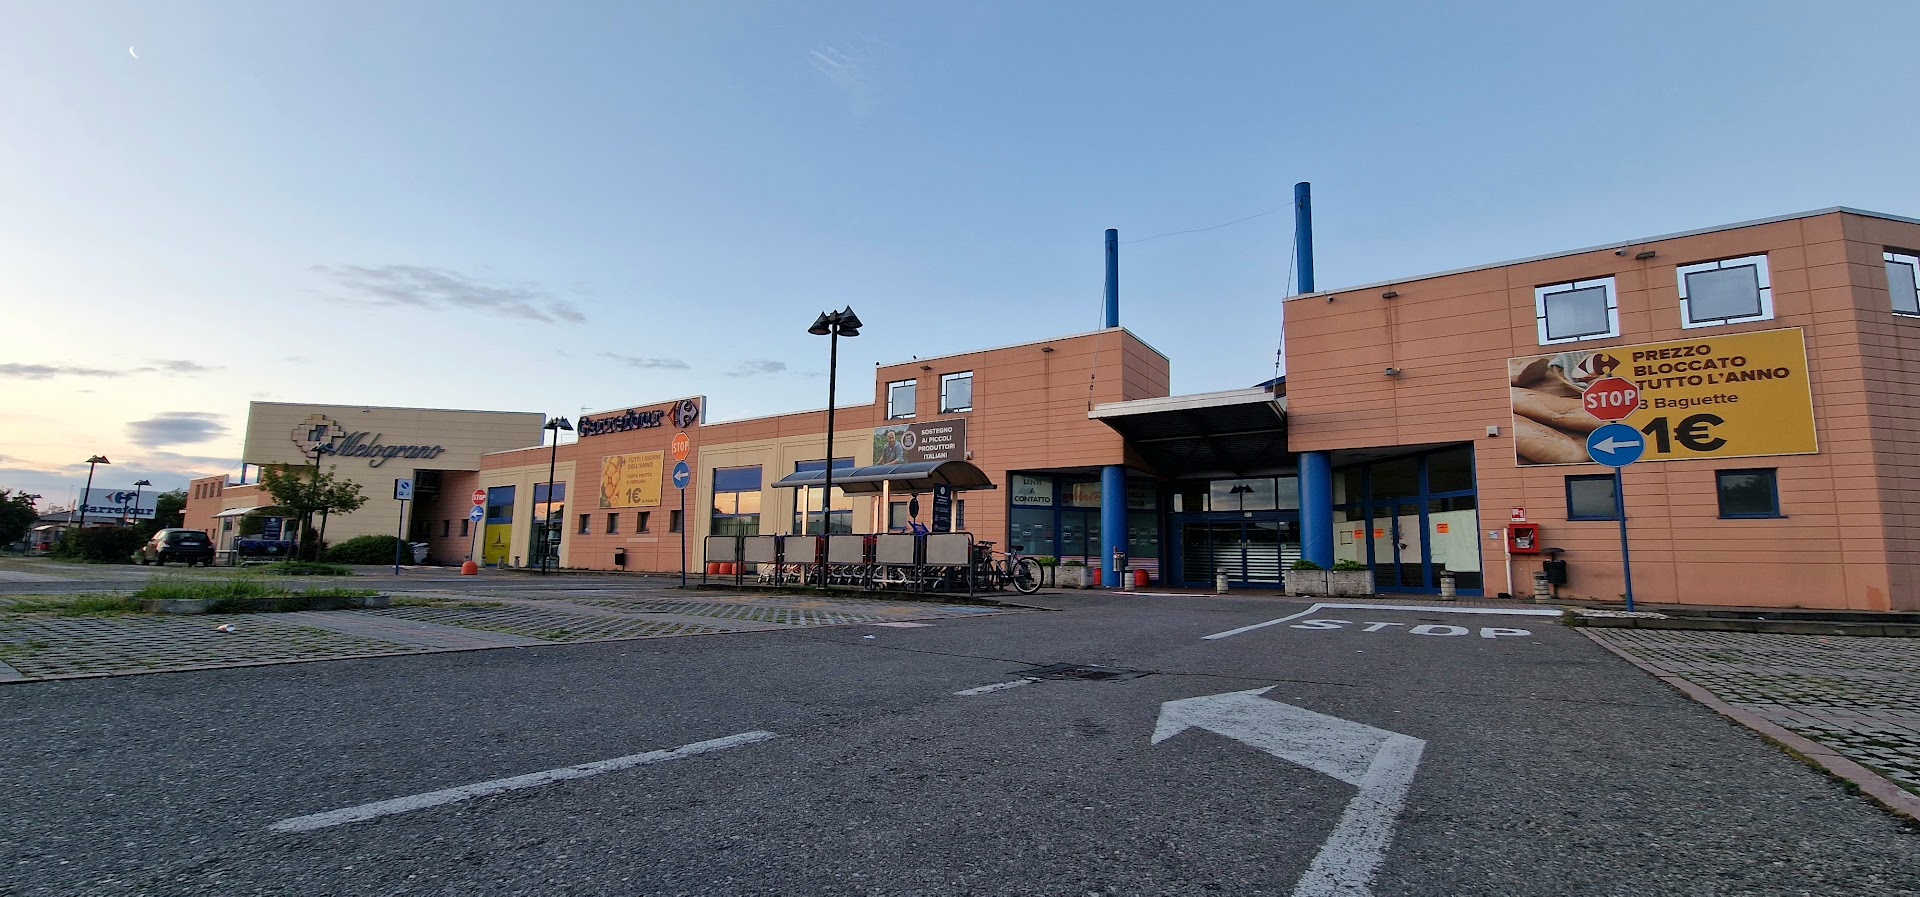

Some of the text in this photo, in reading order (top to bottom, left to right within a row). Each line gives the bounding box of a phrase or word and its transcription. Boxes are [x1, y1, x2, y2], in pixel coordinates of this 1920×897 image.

[1632, 344, 1711, 363] PREZZO
[1633, 356, 1747, 377] BLOCCATO
[1636, 366, 1790, 391] TUTTO L'ANNO
[1586, 389, 1636, 409] STOP
[1655, 393, 1738, 411] Baguette
[577, 408, 664, 437] Carrefour
[921, 426, 953, 436] SOSTEGNO
[929, 435, 952, 443] PICCOLI
[1641, 413, 1727, 455] 1€
[329, 431, 446, 468] Melograno
[673, 441, 689, 453] STOP
[917, 443, 955, 452] PRODUTTORI
[923, 452, 948, 460] ITALIANI
[626, 487, 642, 504] 1€
[1014, 495, 1051, 503] CONTATTO
[79, 504, 155, 515] Carrefour
[1289, 619, 1532, 639] STOP
